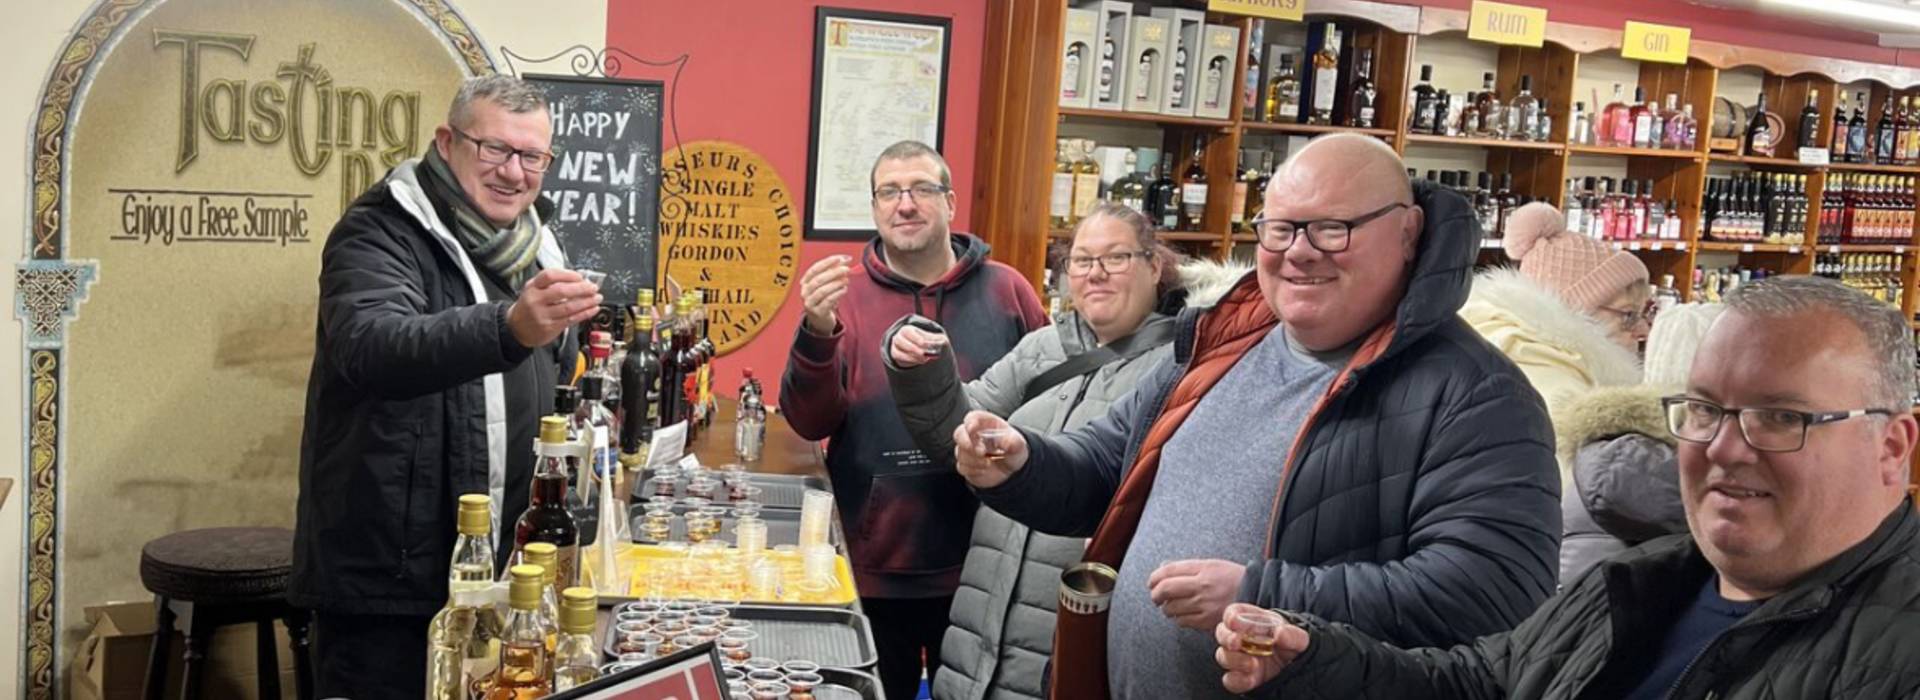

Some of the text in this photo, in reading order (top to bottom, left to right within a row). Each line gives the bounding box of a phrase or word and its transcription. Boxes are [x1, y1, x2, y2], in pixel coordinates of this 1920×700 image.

[1488, 11, 1527, 35] RUM
[1644, 27, 1670, 53] GIN
[153, 28, 420, 176] Tasting
[551, 102, 631, 139] HAPPY
[558, 151, 637, 185] NEW
[681, 178, 754, 197] SINGLE
[122, 194, 174, 246] Enjoy
[180, 205, 192, 235] a
[243, 197, 308, 247] Sample
[543, 190, 636, 225] YEAR!
[686, 201, 740, 219] MALT
[660, 221, 760, 240] WHISKIES
[769, 188, 794, 287] CHOICE
[669, 246, 749, 261] GORDON
[700, 267, 712, 281] &
